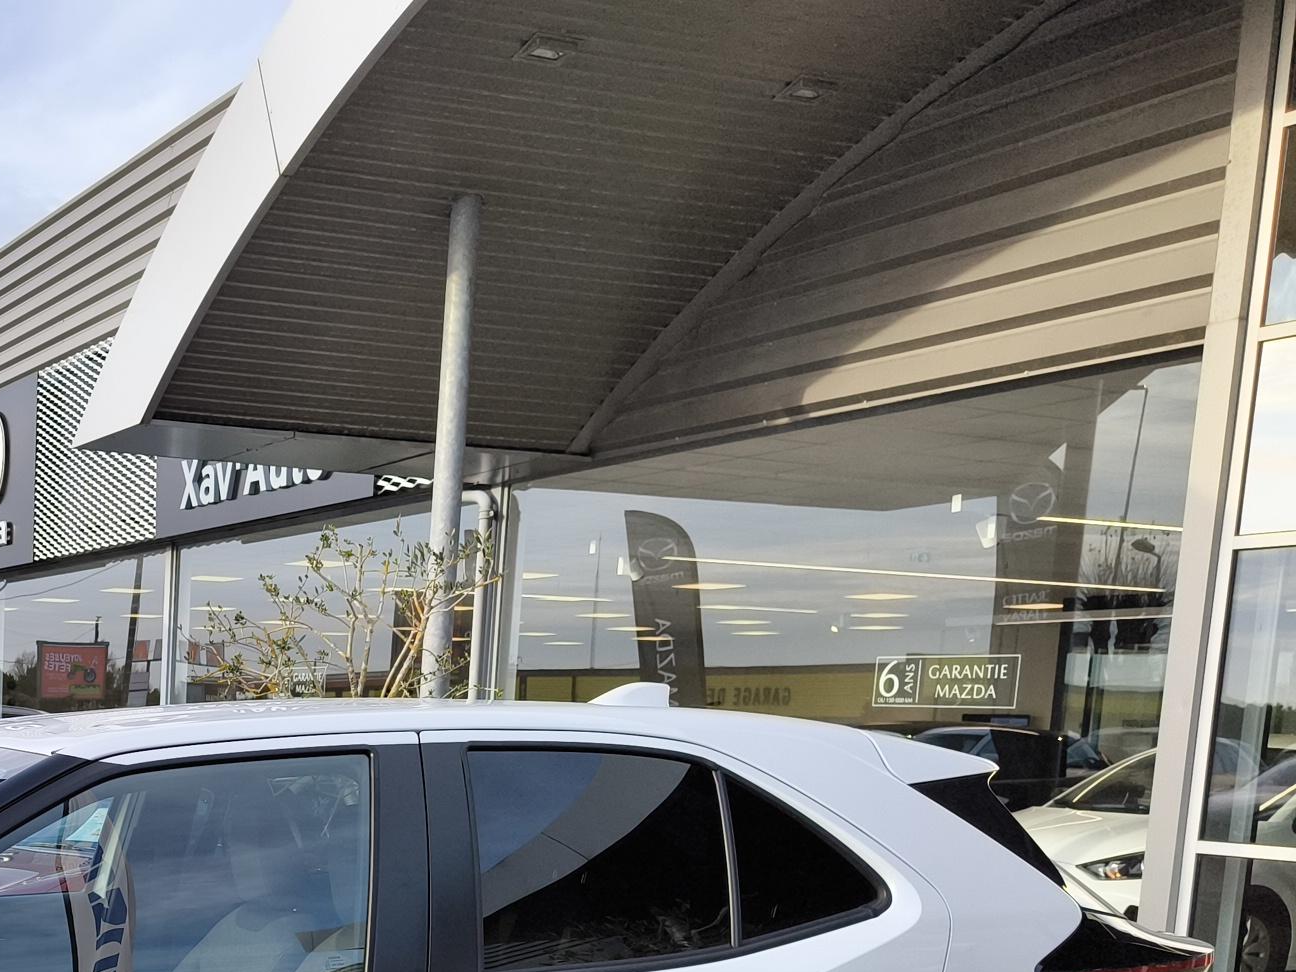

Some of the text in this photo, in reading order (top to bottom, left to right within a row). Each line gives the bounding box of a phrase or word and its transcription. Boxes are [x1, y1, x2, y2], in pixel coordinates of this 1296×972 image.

[180, 459, 323, 510] Xav'Au
[878, 659, 900, 698] 6
[904, 663, 915, 693] ANS
[928, 664, 1008, 680] GARANTIE
[934, 684, 996, 699] MAZDA
